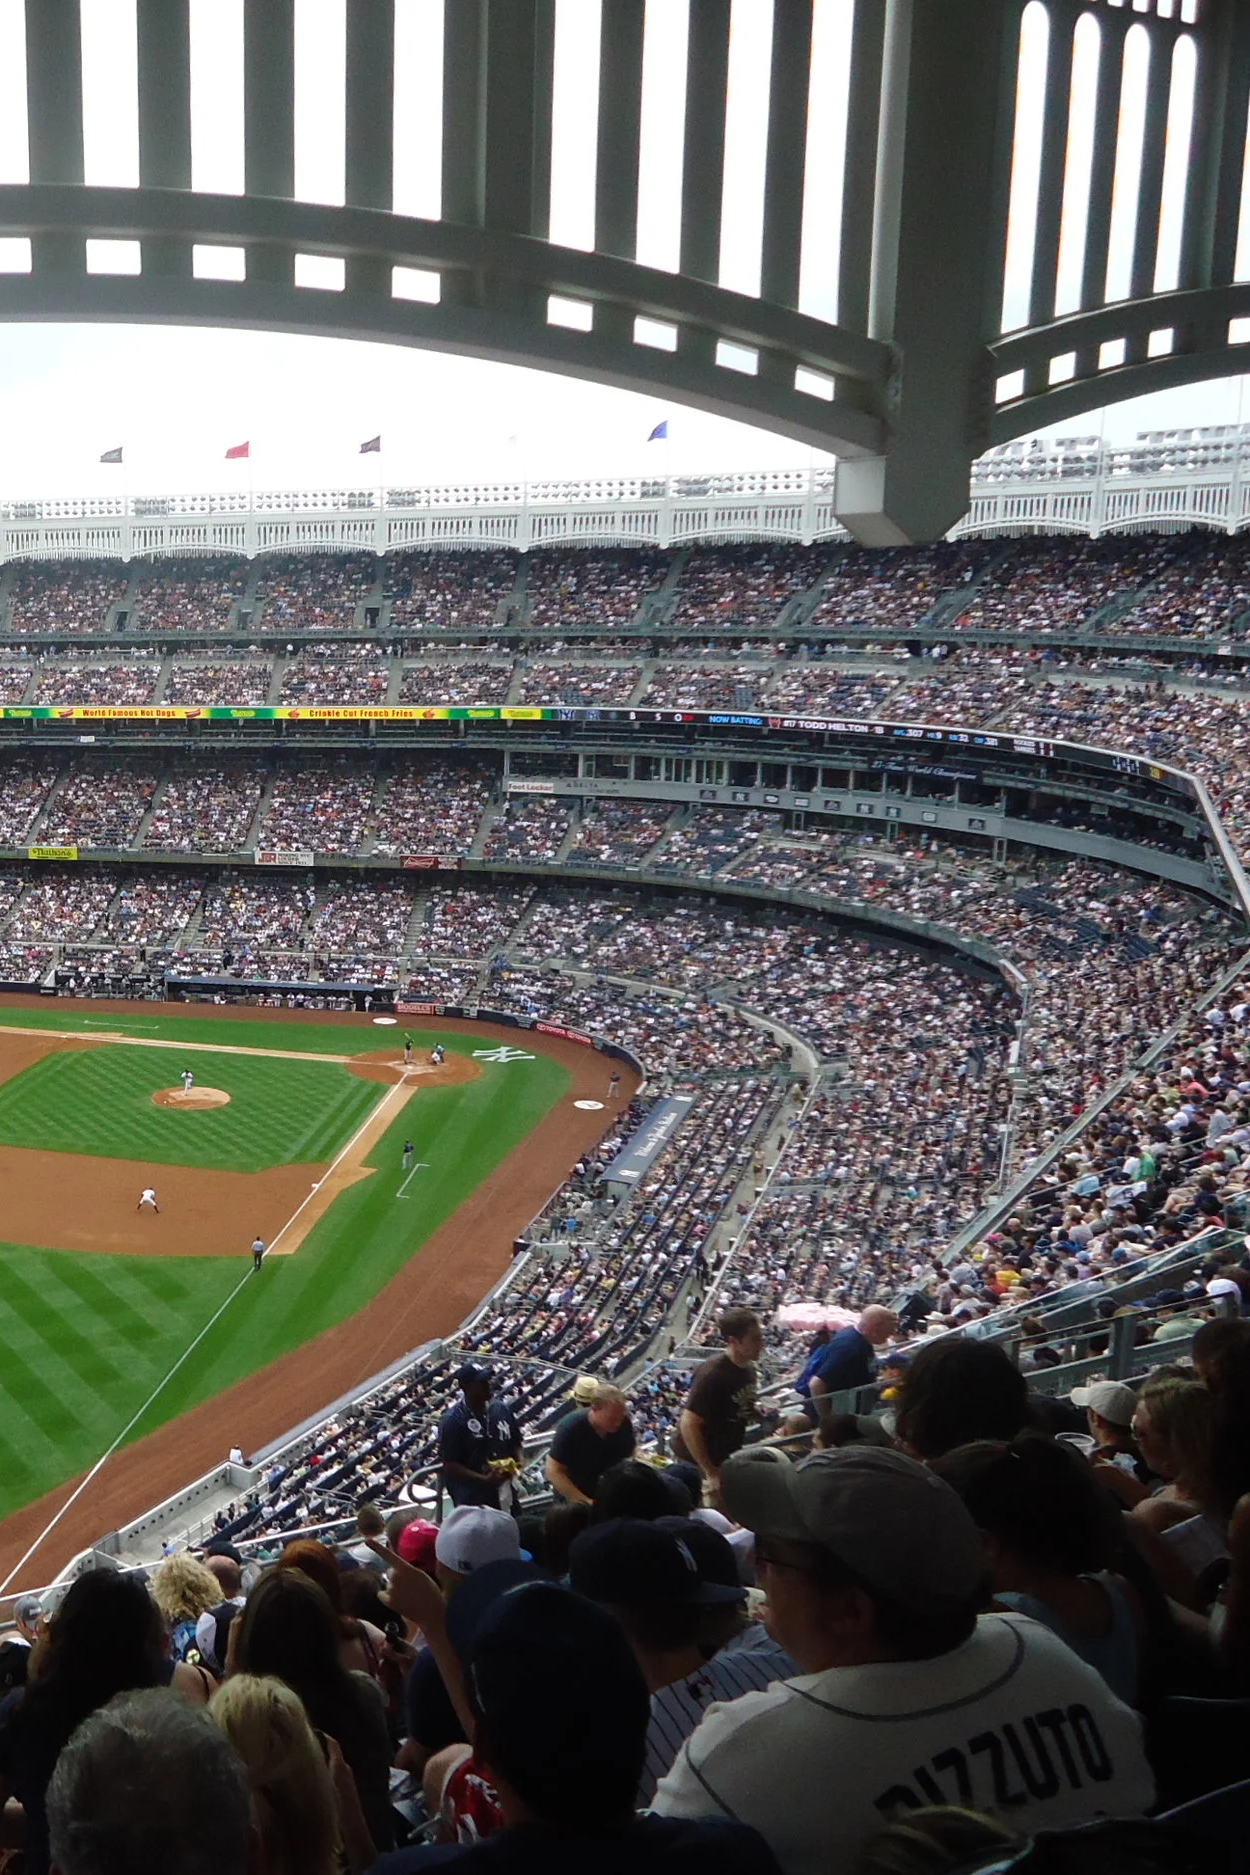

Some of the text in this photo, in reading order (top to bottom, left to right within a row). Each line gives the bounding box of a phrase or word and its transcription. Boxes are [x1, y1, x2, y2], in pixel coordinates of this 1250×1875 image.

[629, 712, 636, 720] B
[709, 715, 729, 723] NOW
[798, 721, 827, 730] TODD
[829, 722, 868, 732] HELTON
[527, 783, 553, 791] Locker
[544, 1025, 566, 1035] TOYOTA
